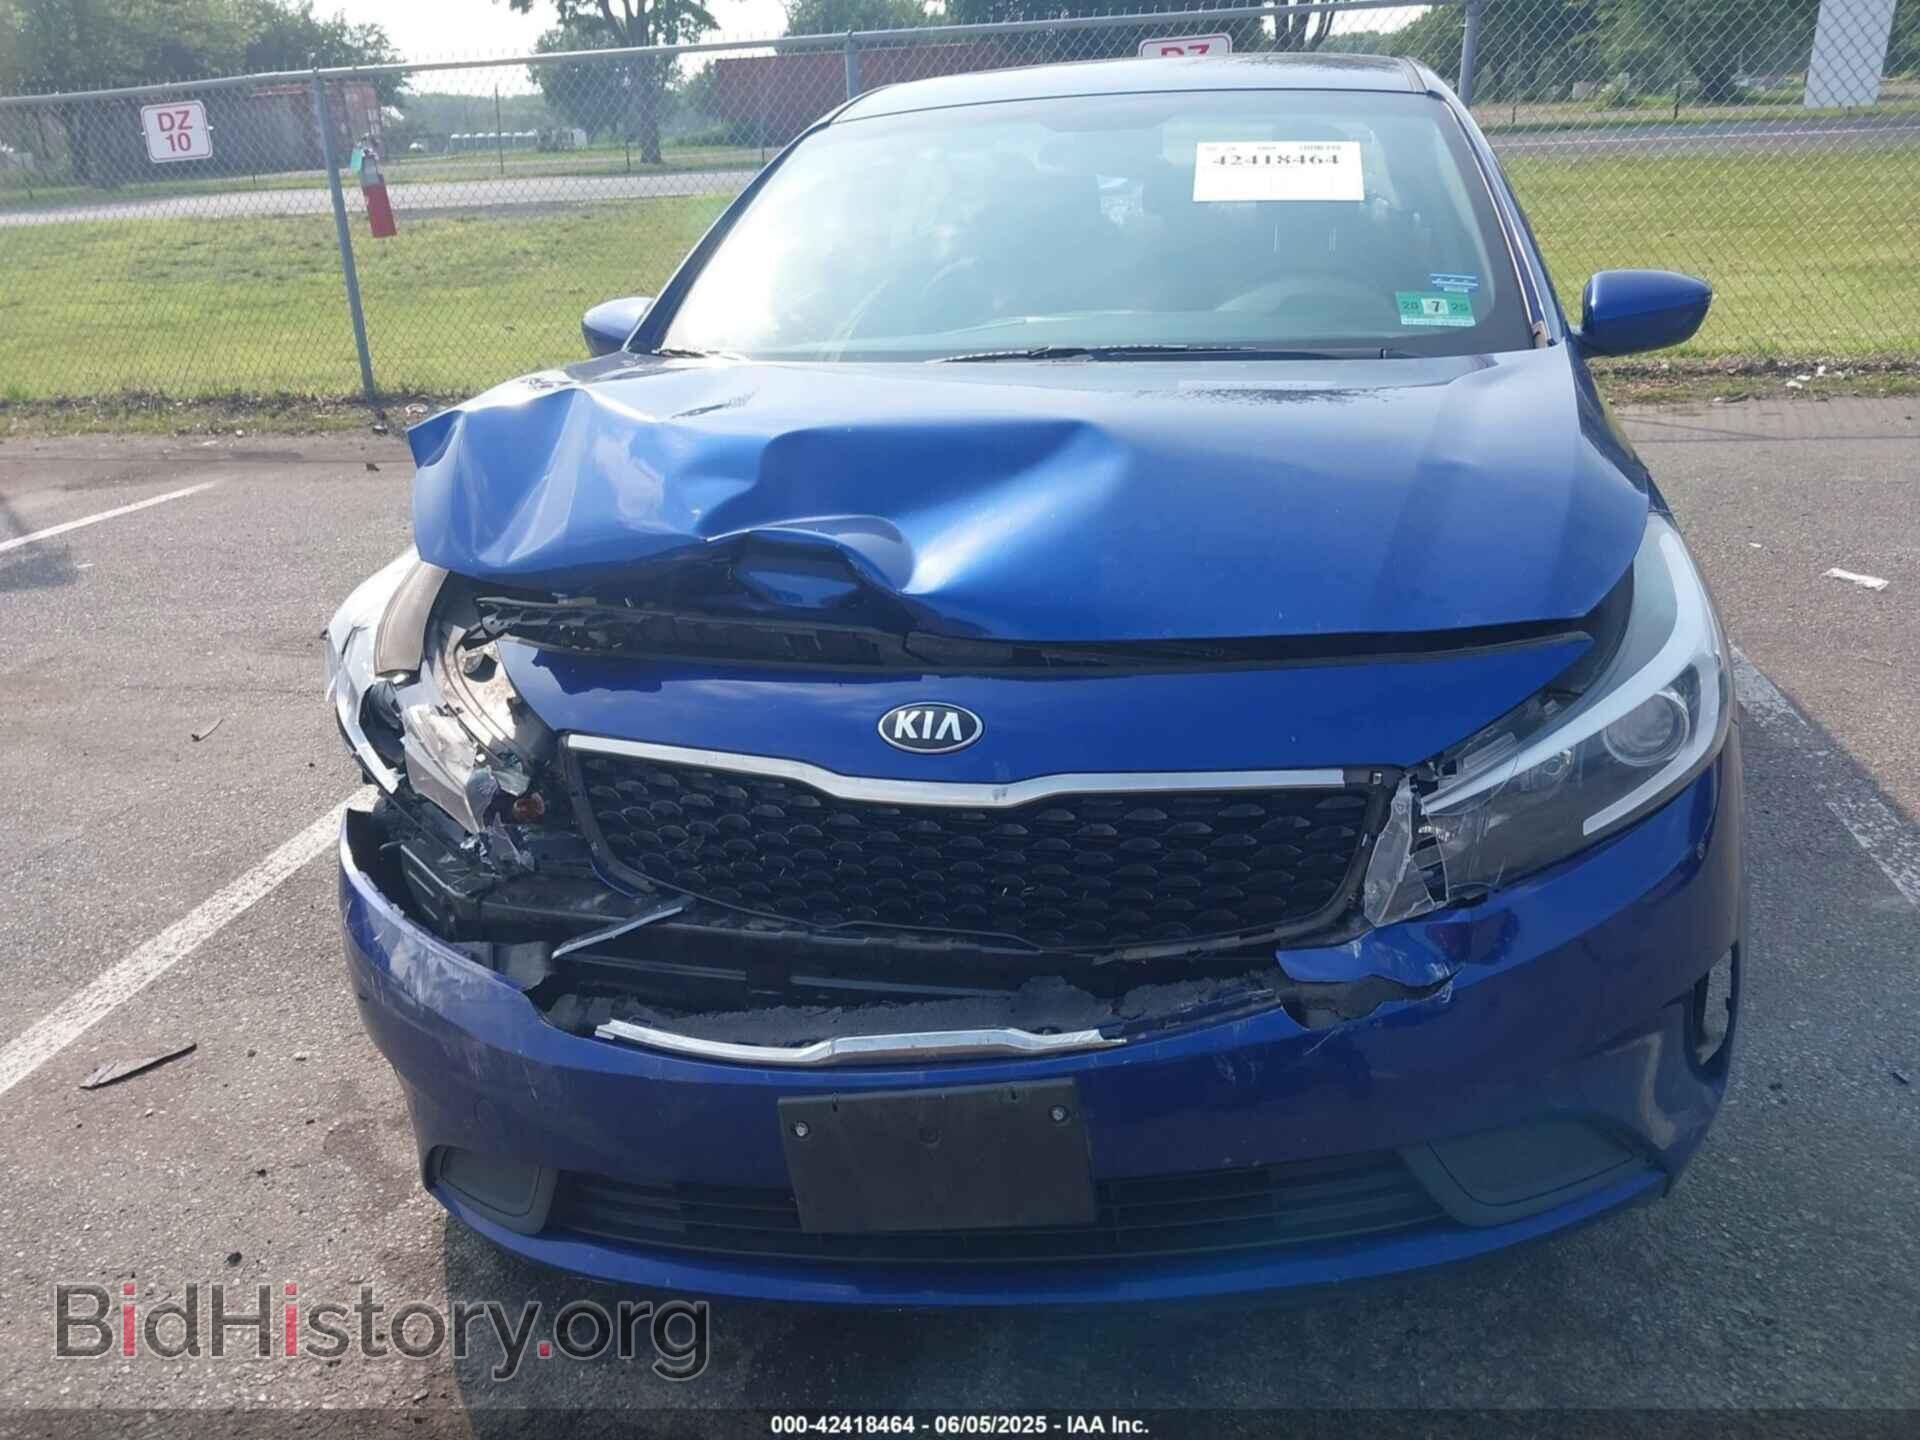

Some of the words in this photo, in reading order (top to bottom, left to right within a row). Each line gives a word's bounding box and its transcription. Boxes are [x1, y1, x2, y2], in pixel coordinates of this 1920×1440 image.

[157, 110, 193, 132] DZ
[165, 132, 192, 152] 10
[1212, 154, 1339, 166] 42418464
[1431, 300, 1441, 312] 7
[894, 710, 962, 740] KIA
